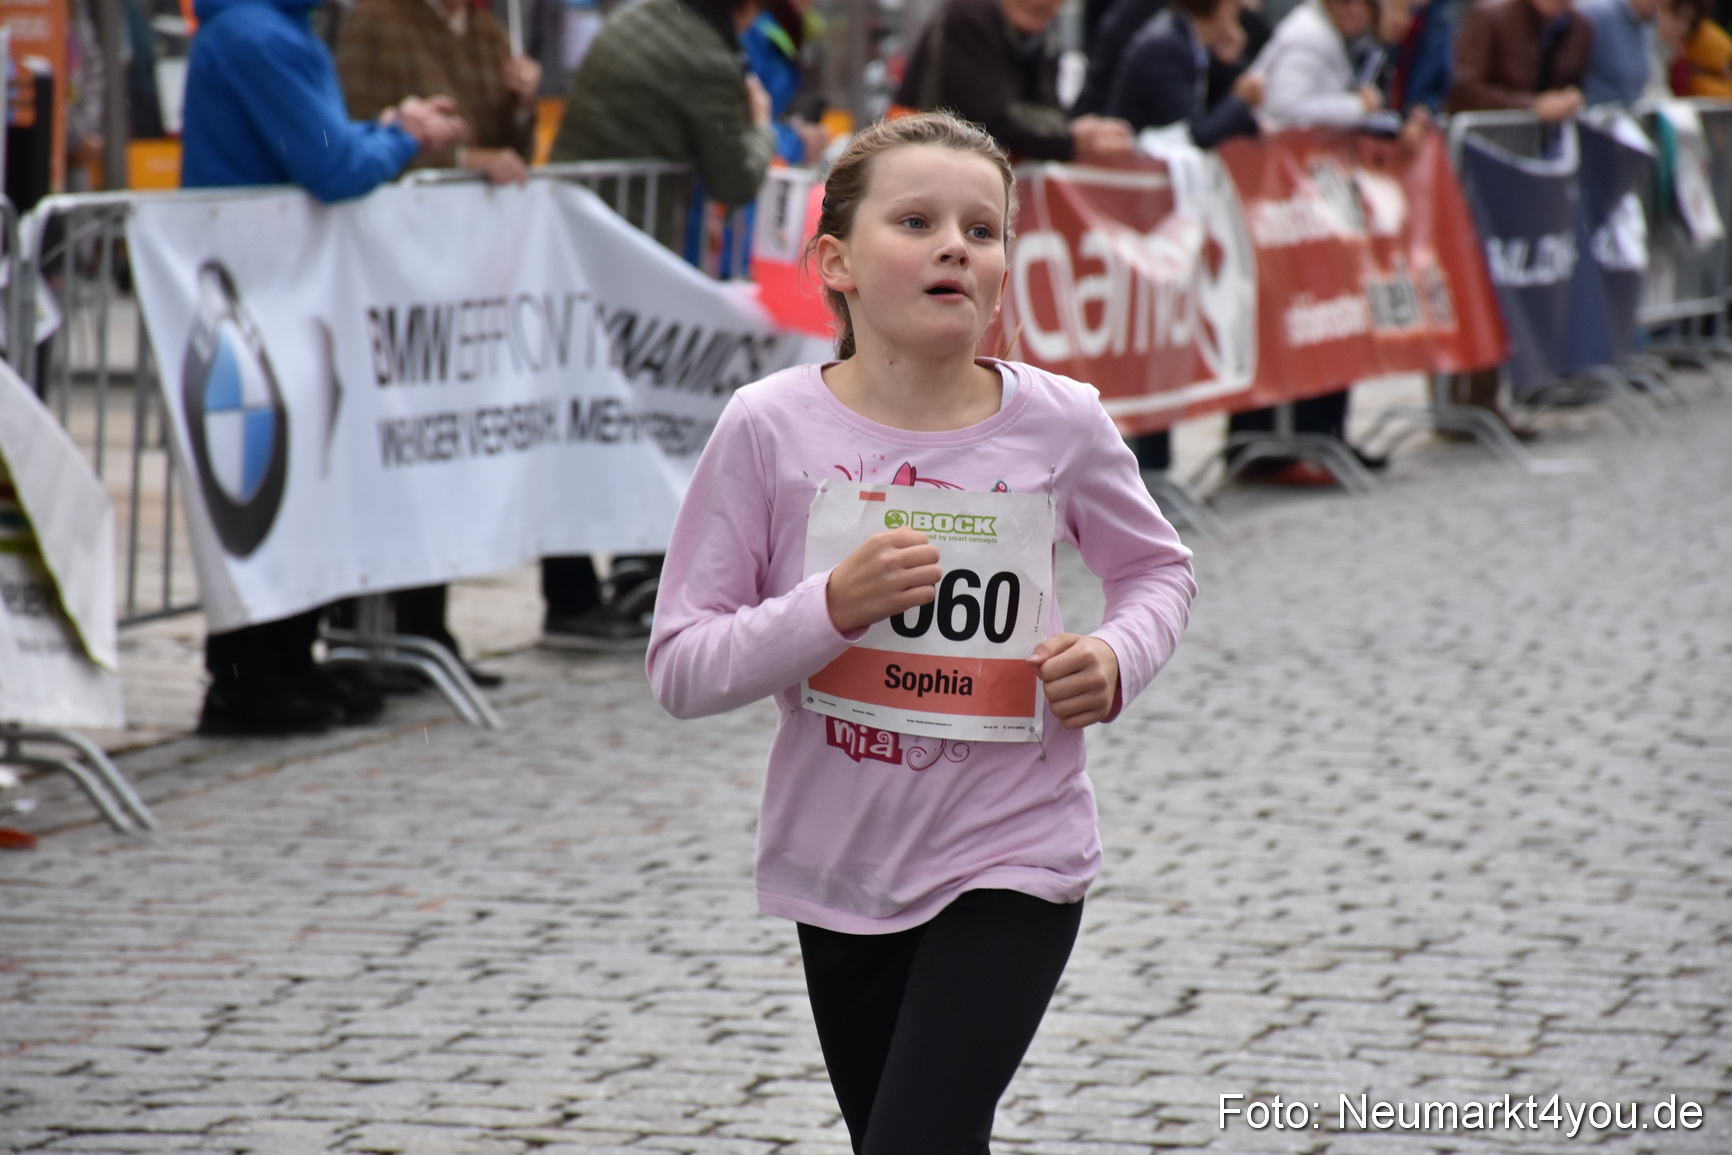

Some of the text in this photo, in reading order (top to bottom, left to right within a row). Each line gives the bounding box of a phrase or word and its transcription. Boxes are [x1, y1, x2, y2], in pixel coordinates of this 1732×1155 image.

[368, 303, 453, 388] BMW
[911, 511, 997, 536] BOCK
[948, 535, 967, 543] smart
[968, 537, 998, 545] concepts
[884, 664, 973, 698] Sophia
[833, 719, 894, 758] mia
